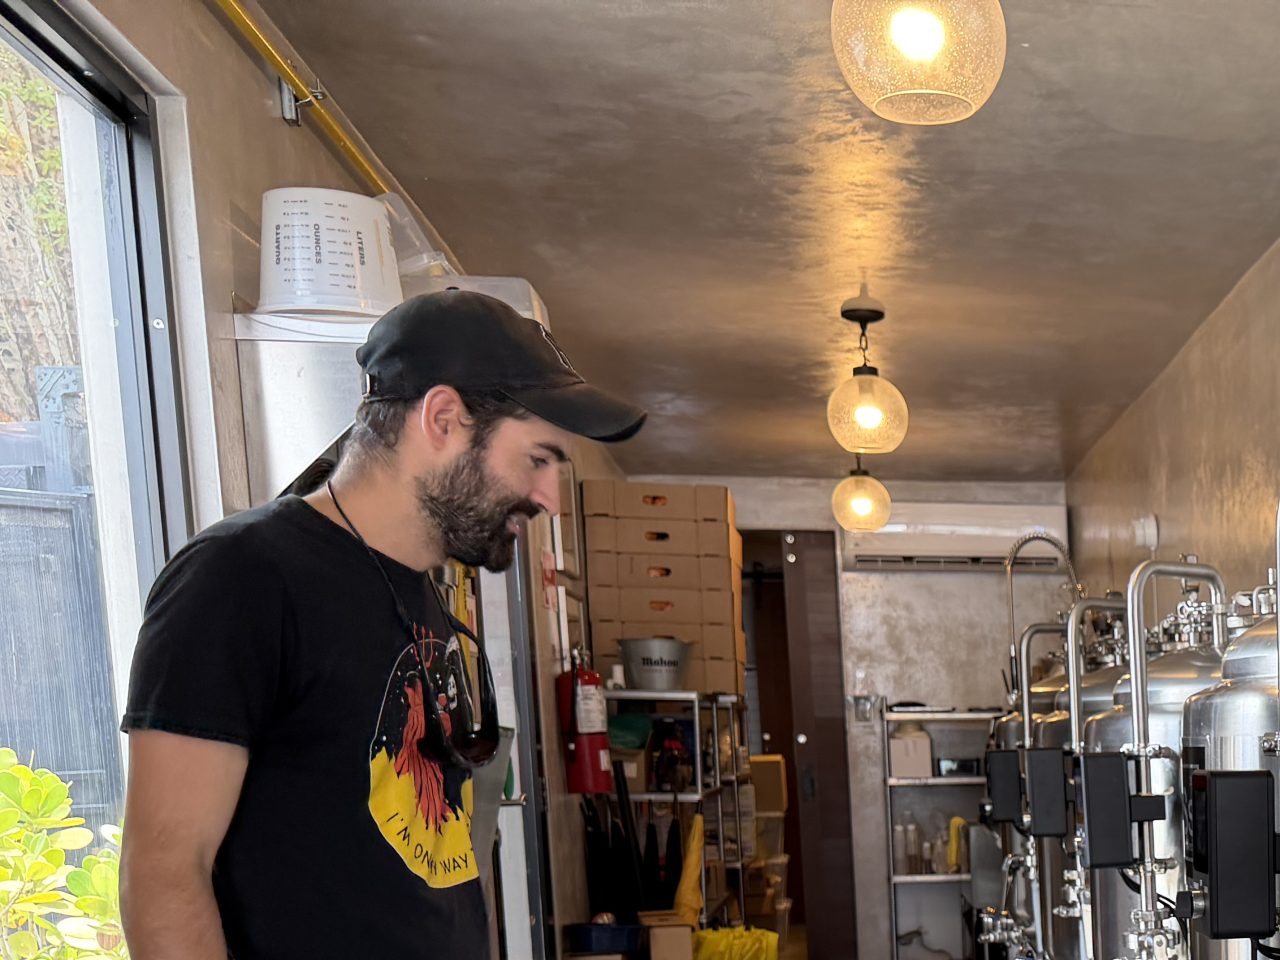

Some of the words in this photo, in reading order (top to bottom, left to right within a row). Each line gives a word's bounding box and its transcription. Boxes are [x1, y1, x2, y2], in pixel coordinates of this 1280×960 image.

[313, 223, 322, 265] OUNCES
[356, 231, 365, 265] LITERS
[386, 812, 411, 847] I'M
[439, 853, 468, 875] WAY
